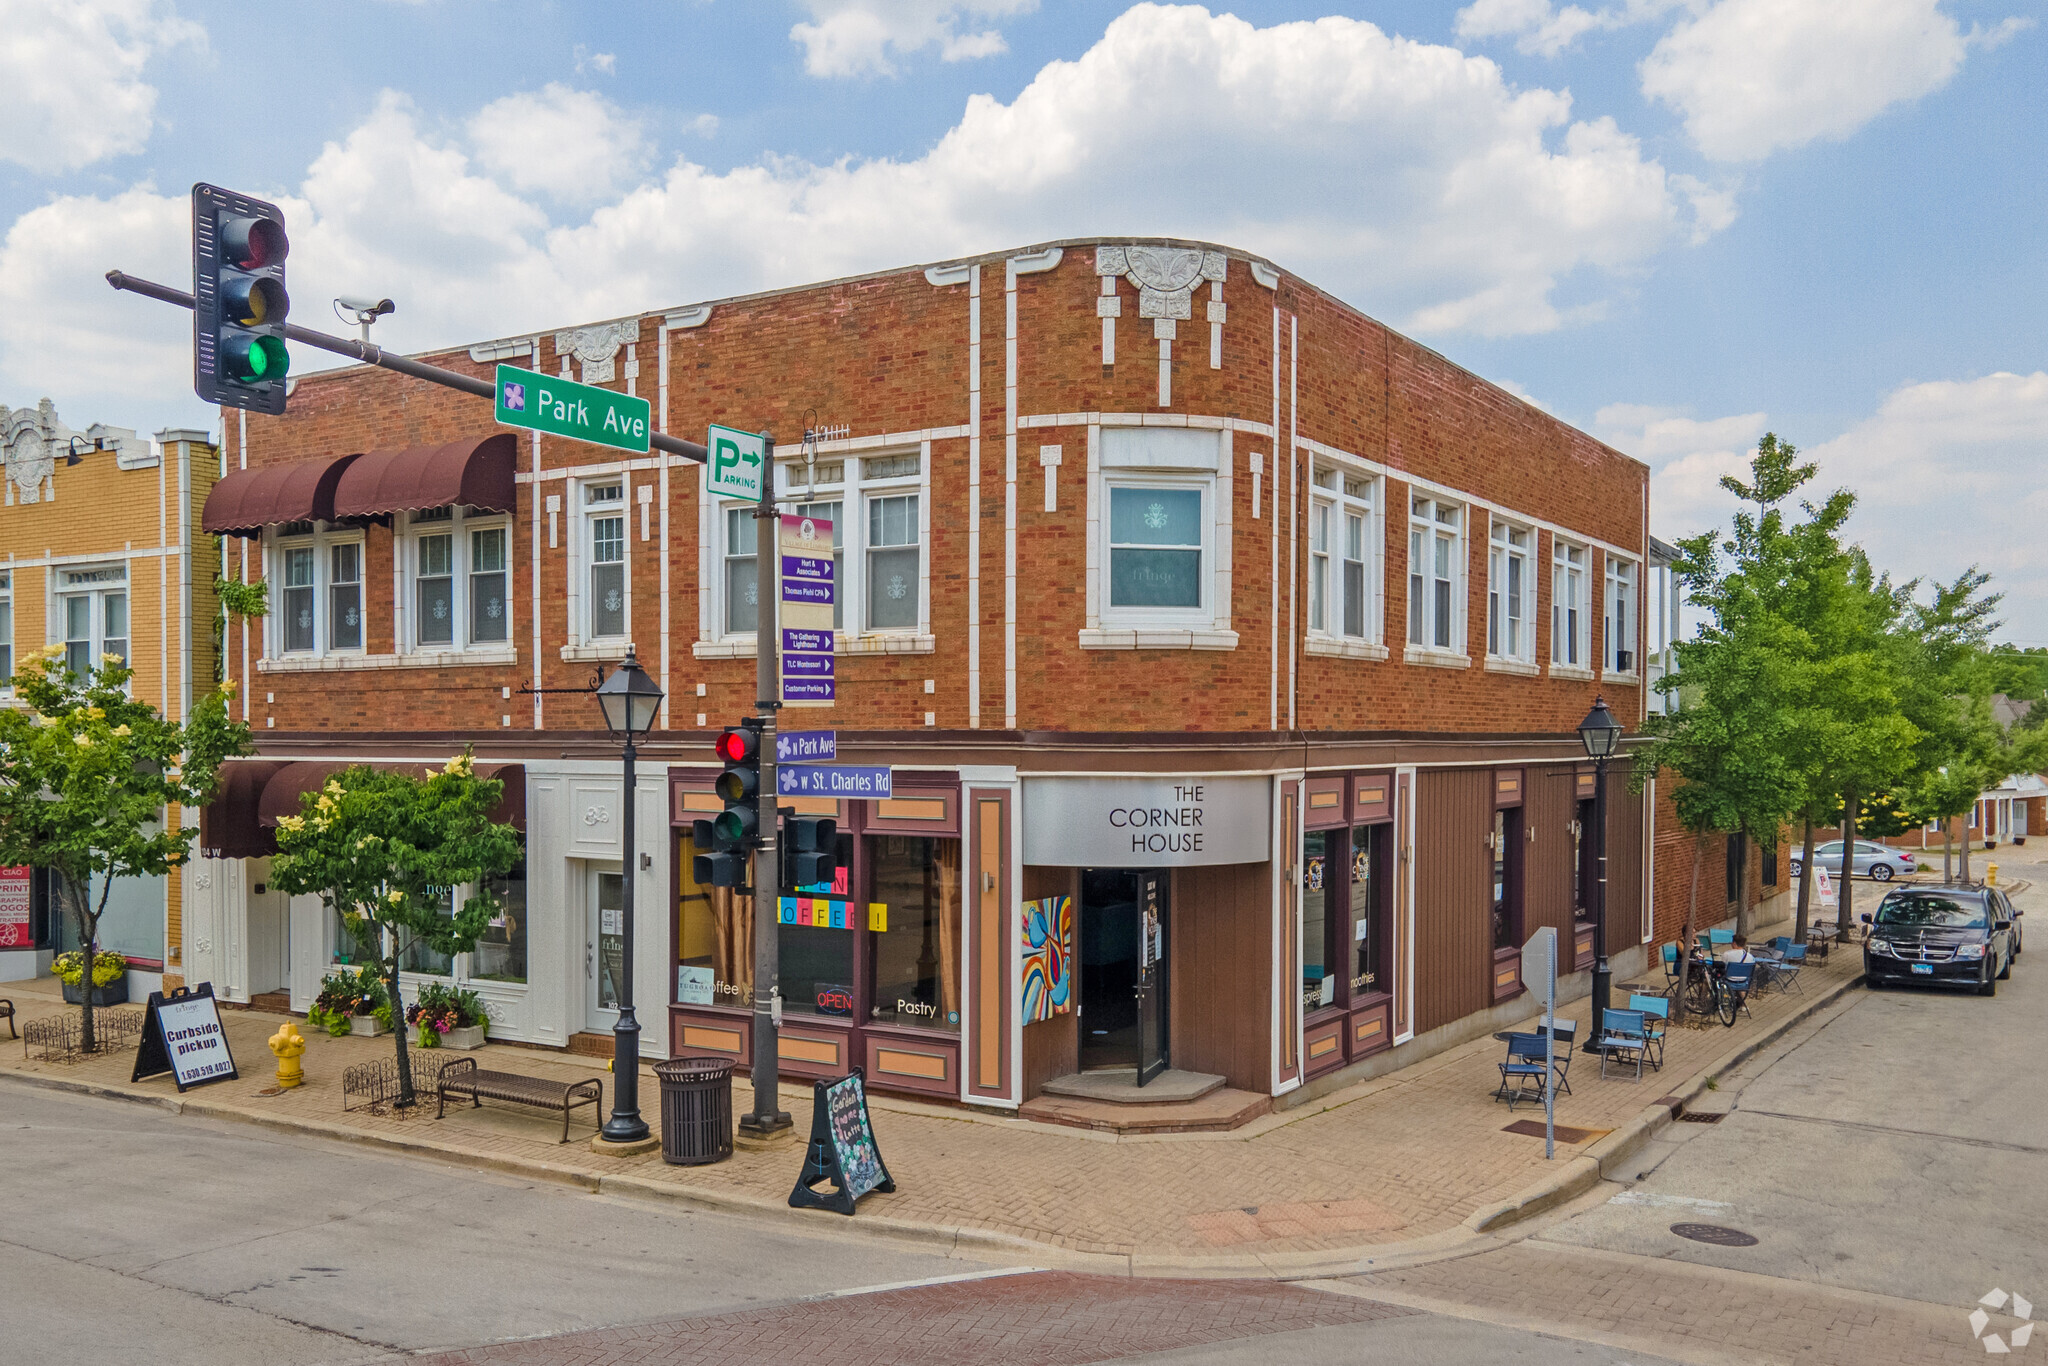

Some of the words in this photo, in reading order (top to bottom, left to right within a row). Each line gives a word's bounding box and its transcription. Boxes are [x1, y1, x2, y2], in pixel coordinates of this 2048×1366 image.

[538, 389, 590, 427] Park
[602, 405, 645, 438] Ave
[796, 567, 820, 577] Associates
[784, 586, 803, 596] Thomas
[814, 589, 825, 597] CPA
[785, 684, 807, 693] Customer
[806, 684, 824, 694] Parking
[792, 742, 798, 756] N
[799, 737, 818, 755] Park
[819, 736, 834, 754] Ave
[801, 775, 808, 790] W
[812, 771, 828, 790] St.
[831, 771, 871, 791] Charles
[875, 772, 889, 792] Rd
[1174, 785, 1204, 802] THE
[1109, 808, 1204, 828] CORNER
[1132, 833, 1204, 853] HOUSE
[0, 904, 29, 912] OGOS
[709, 980, 739, 996] offee
[608, 1001, 618, 1010] 102
[817, 992, 852, 1010] OPEN
[897, 998, 937, 1019] Pastry
[166, 1022, 220, 1043] Curbside
[177, 1037, 218, 1056] pickup
[181, 1060, 231, 1081] 1.630.519.4027
